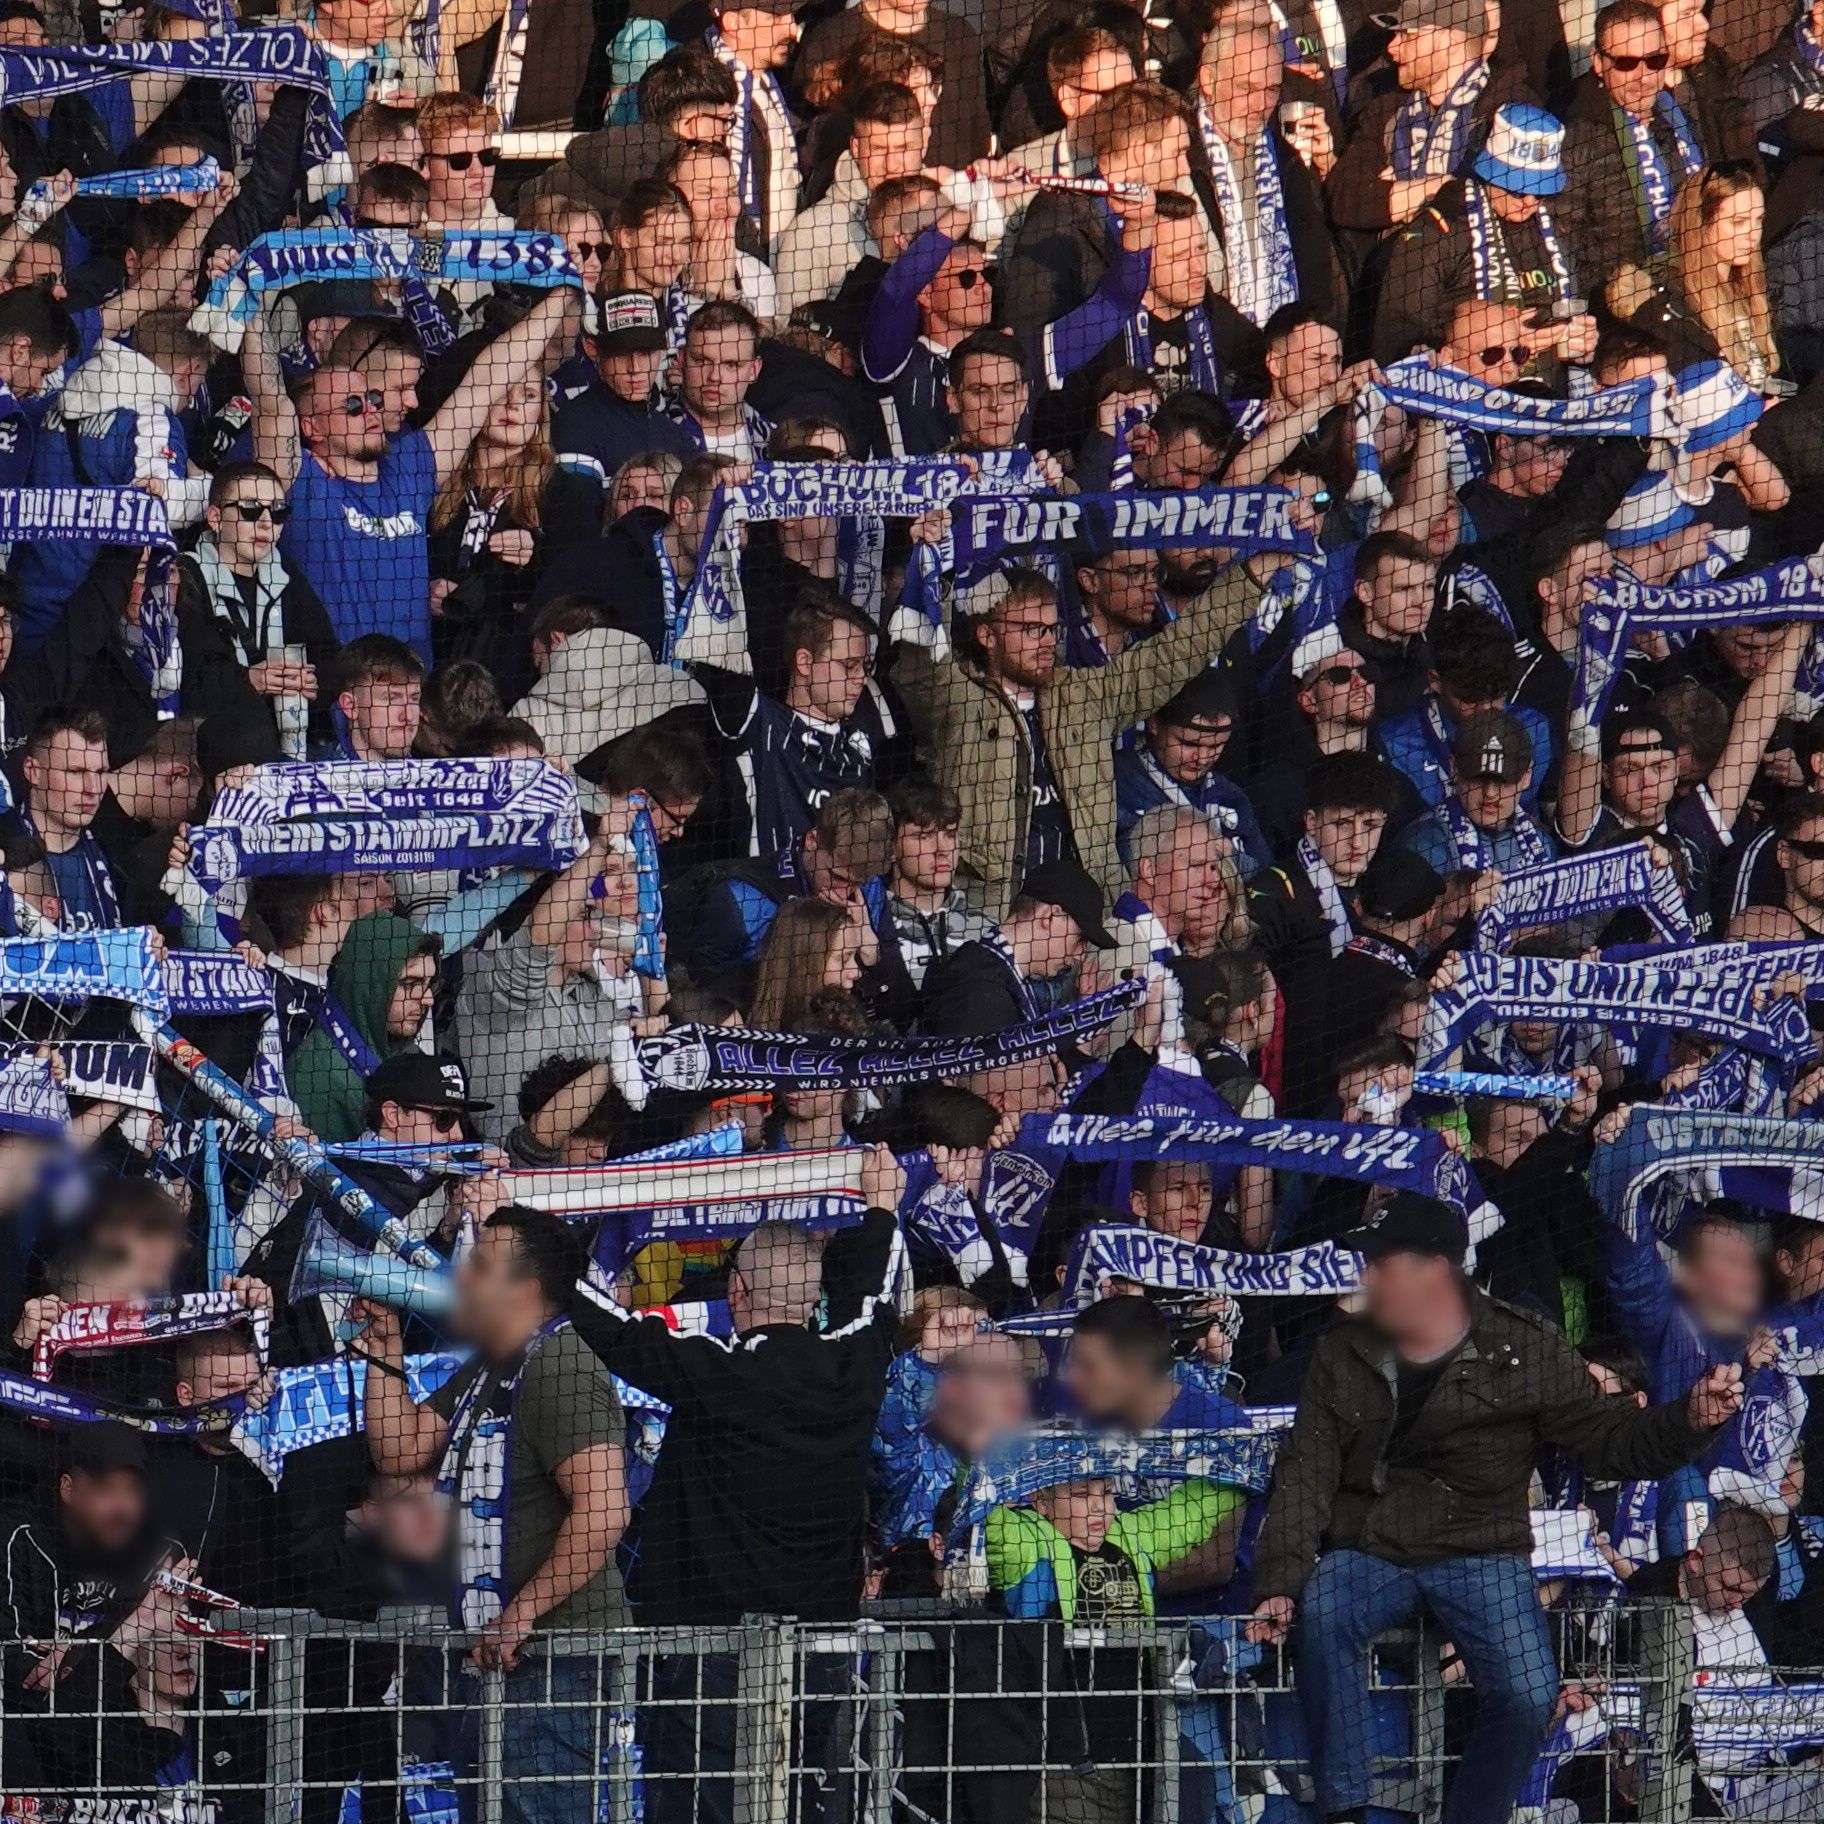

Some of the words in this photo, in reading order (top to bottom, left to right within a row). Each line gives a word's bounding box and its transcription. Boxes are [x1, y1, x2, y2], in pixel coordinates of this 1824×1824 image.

[745, 467, 905, 504] BOCHUM
[969, 494, 1082, 550] FÜR
[1112, 487, 1295, 543] IMMER
[381, 790, 425, 809] Seit
[432, 790, 485, 808] 1848
[241, 820, 320, 857] MEIN
[328, 813, 544, 855] STAMMPLATZ
[716, 1036, 848, 1078] ALLEZ
[796, 1076, 842, 1090] WIRD
[851, 1069, 931, 1089] NIEMALS
[935, 1043, 1060, 1083] UNTERGEHEN
[1047, 1112, 1148, 1146] Alles
[1158, 1112, 1245, 1155] für
[1251, 1120, 1341, 1157] den
[1222, 1247, 1293, 1295] UND
